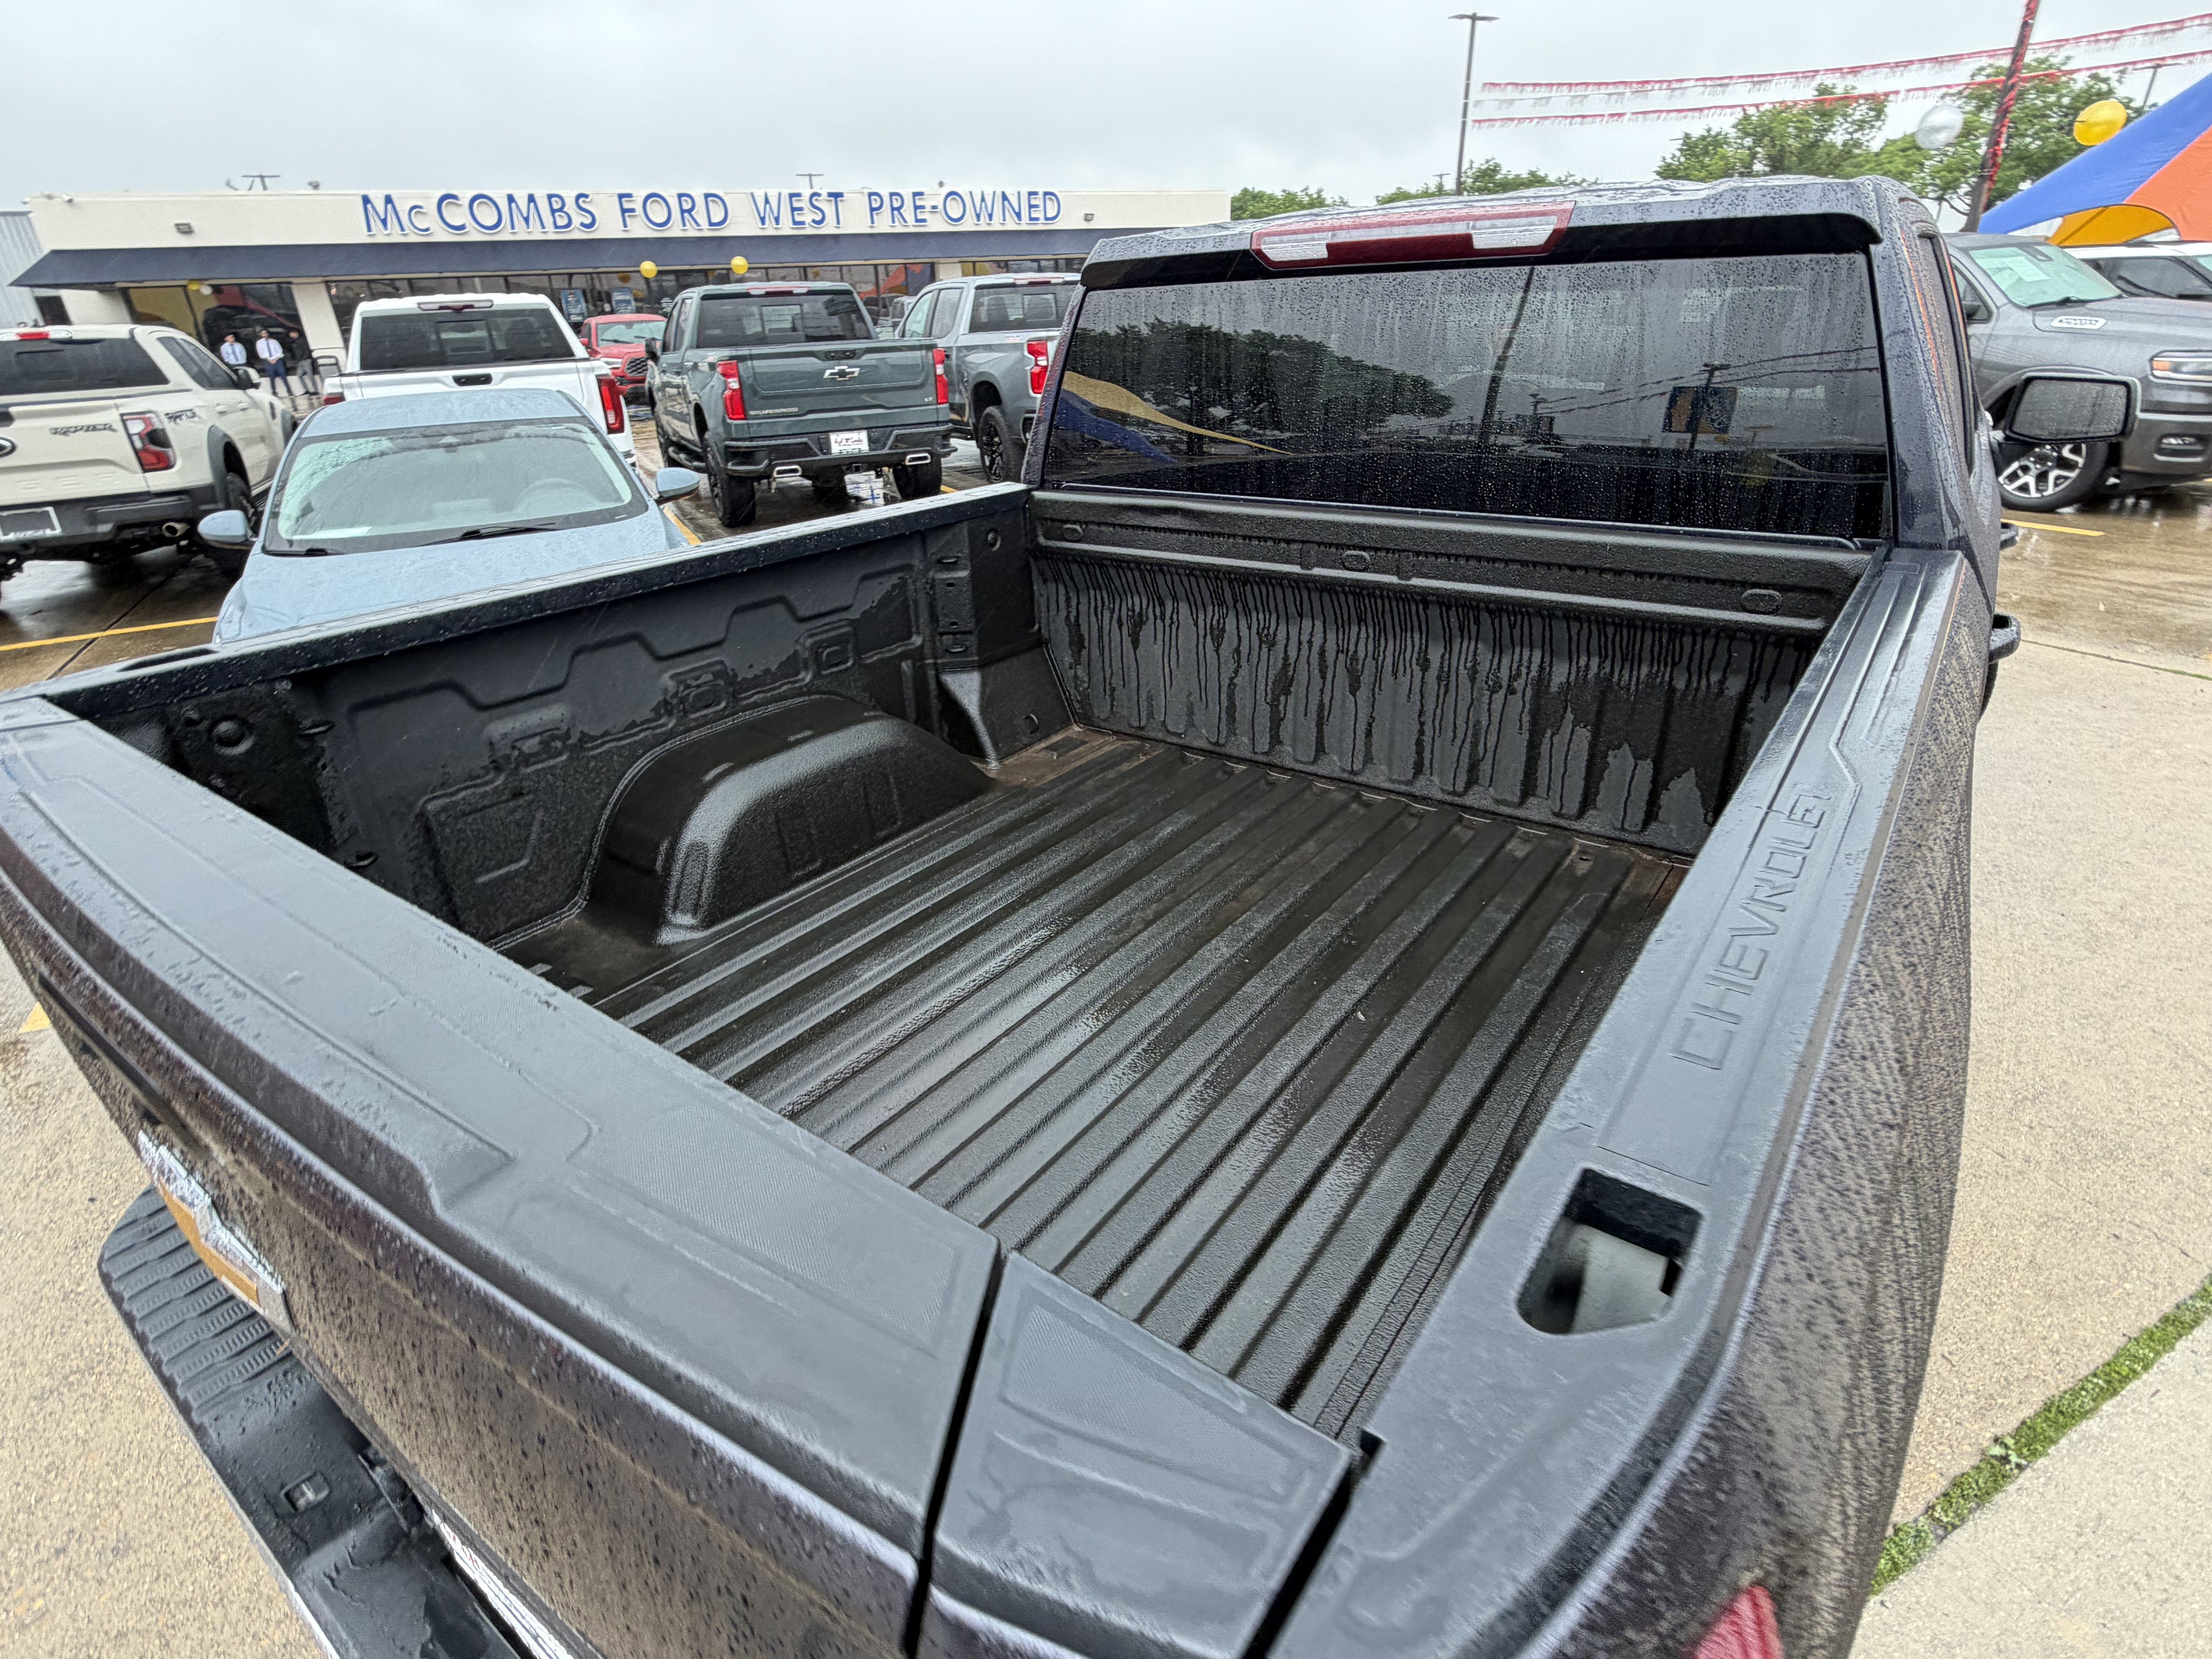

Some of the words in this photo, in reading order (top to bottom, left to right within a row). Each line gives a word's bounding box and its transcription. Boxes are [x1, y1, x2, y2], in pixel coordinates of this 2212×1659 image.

[617, 192, 729, 228] FORD
[750, 192, 845, 227] WEST
[867, 191, 1061, 226] PRE-OWNED
